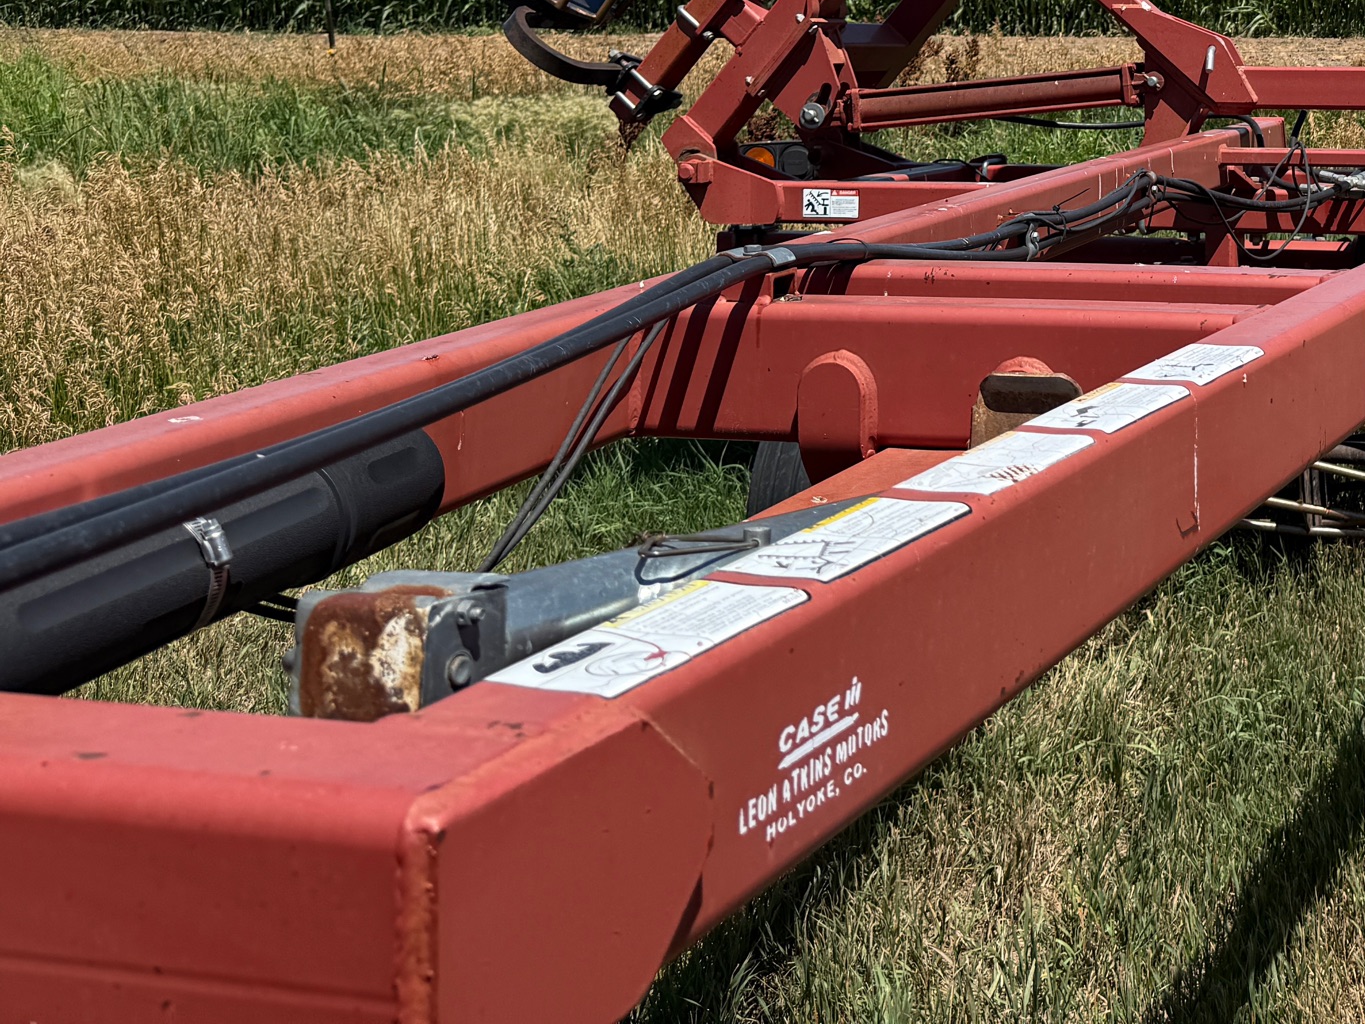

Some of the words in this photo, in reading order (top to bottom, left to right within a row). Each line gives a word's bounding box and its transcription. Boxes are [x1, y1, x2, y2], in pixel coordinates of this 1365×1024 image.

[779, 695, 840, 752] CASE
[739, 784, 777, 835] LEON
[783, 747, 832, 804] ATKINS
[766, 780, 840, 842] HOLYOKE,
[844, 763, 867, 785] CO.
